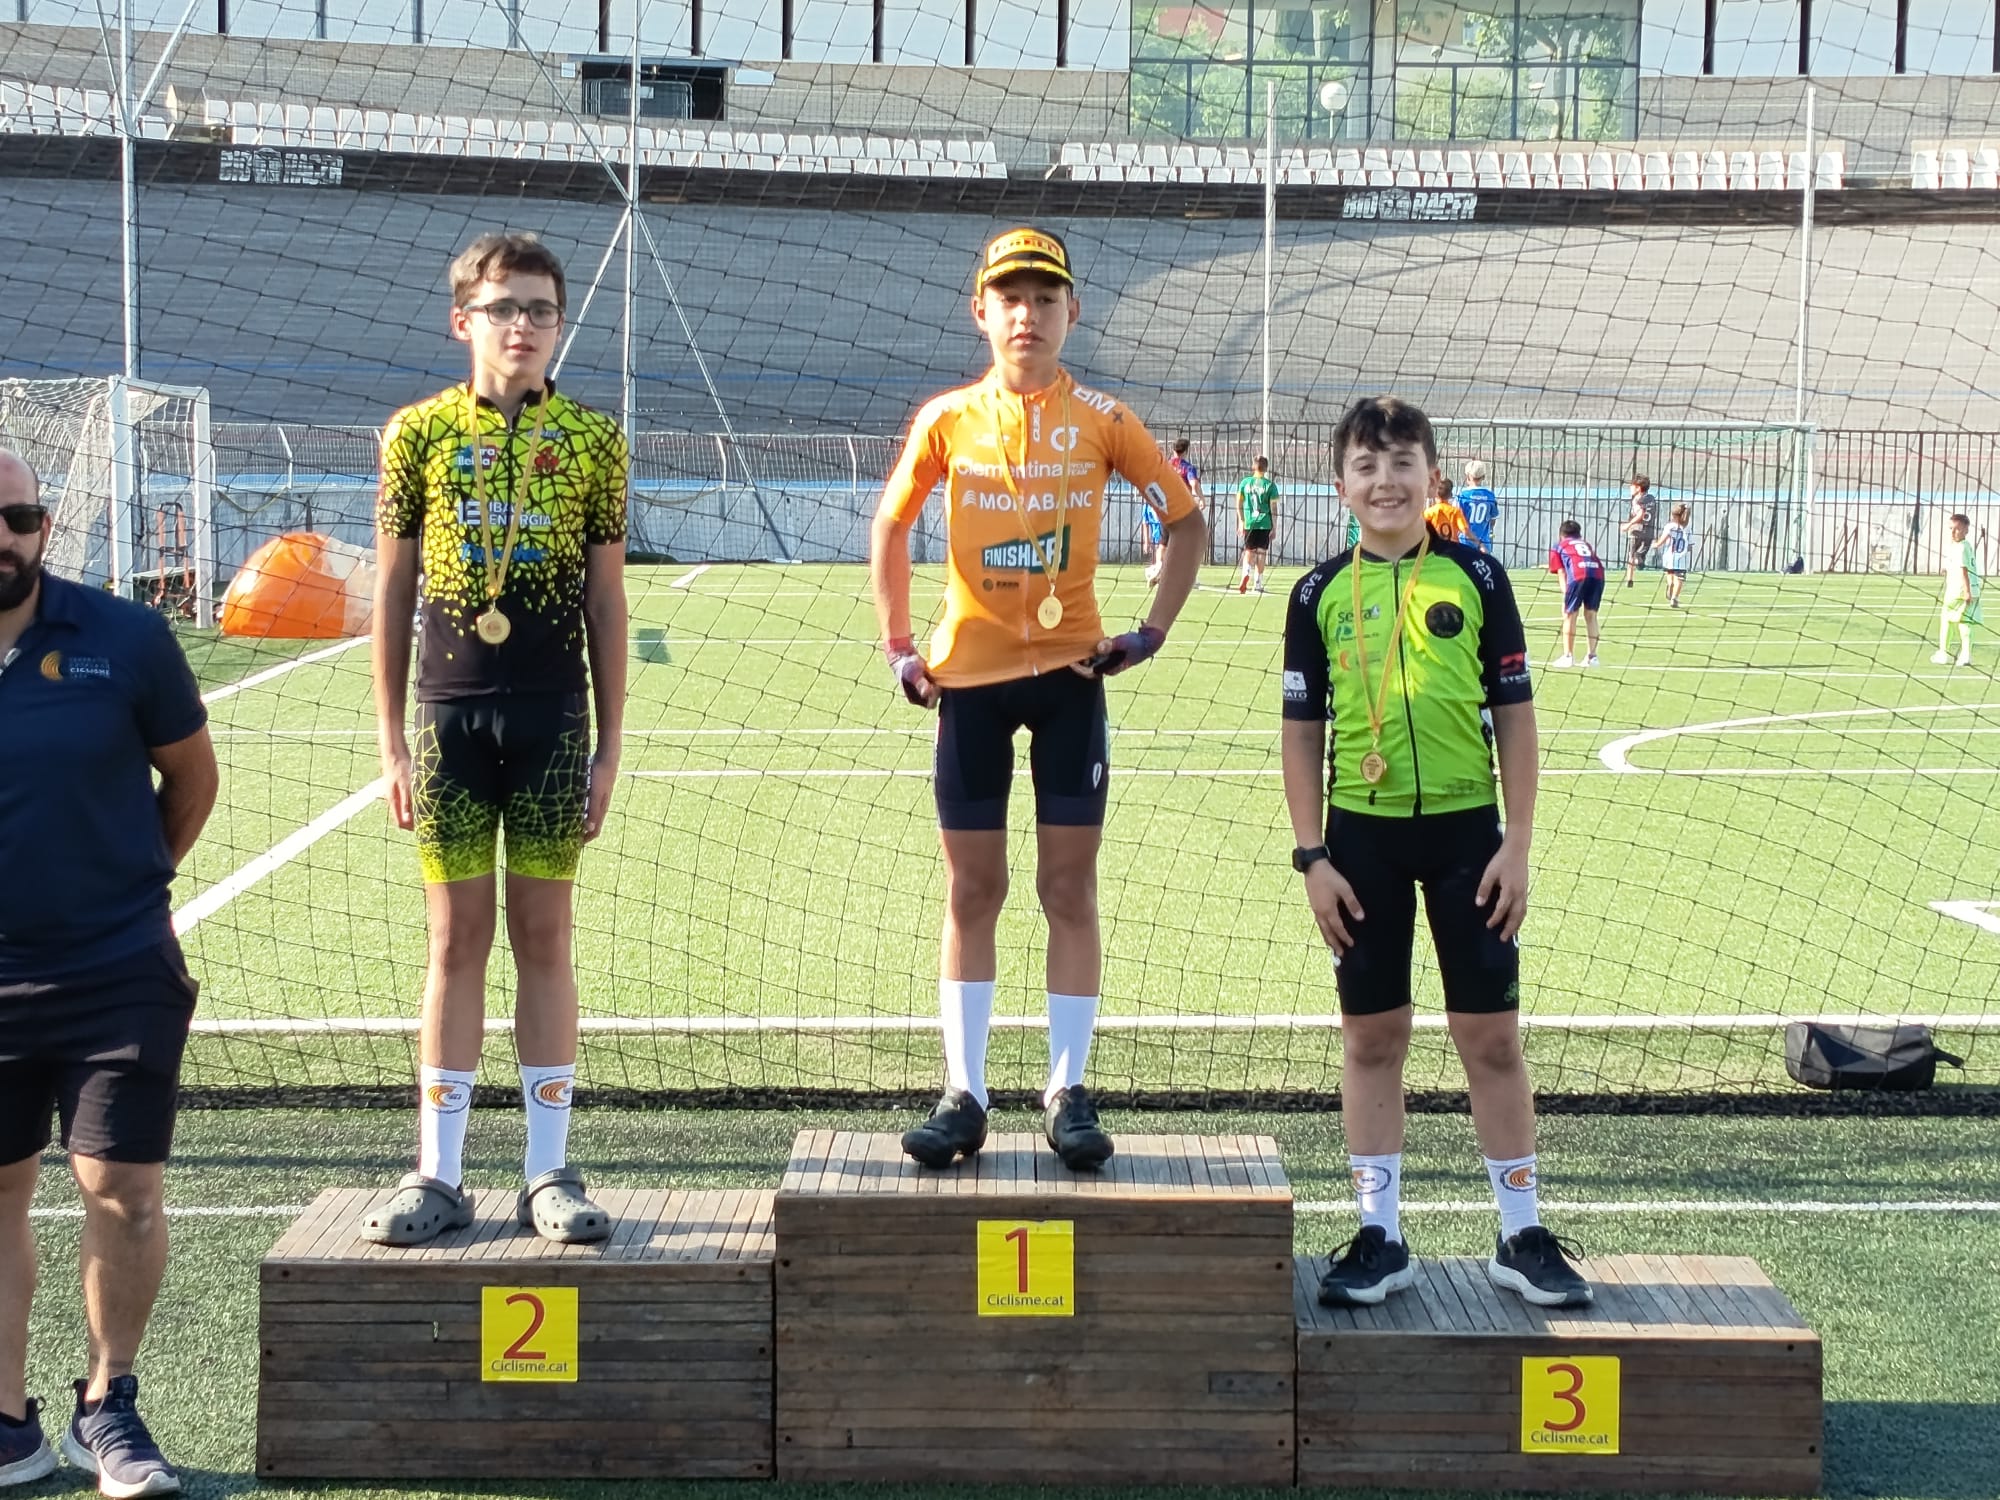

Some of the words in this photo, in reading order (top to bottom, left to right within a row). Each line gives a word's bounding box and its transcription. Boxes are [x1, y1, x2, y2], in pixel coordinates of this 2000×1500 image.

[1468, 502, 1487, 524] 10
[1005, 1226, 1028, 1293] 1
[987, 1293, 1065, 1307] Ciclisme.cat
[503, 1292, 547, 1360] 2
[491, 1359, 569, 1373] Ciclisme.cat
[1543, 1363, 1587, 1432] 3
[1530, 1430, 1609, 1445] Ciclisme.cat
